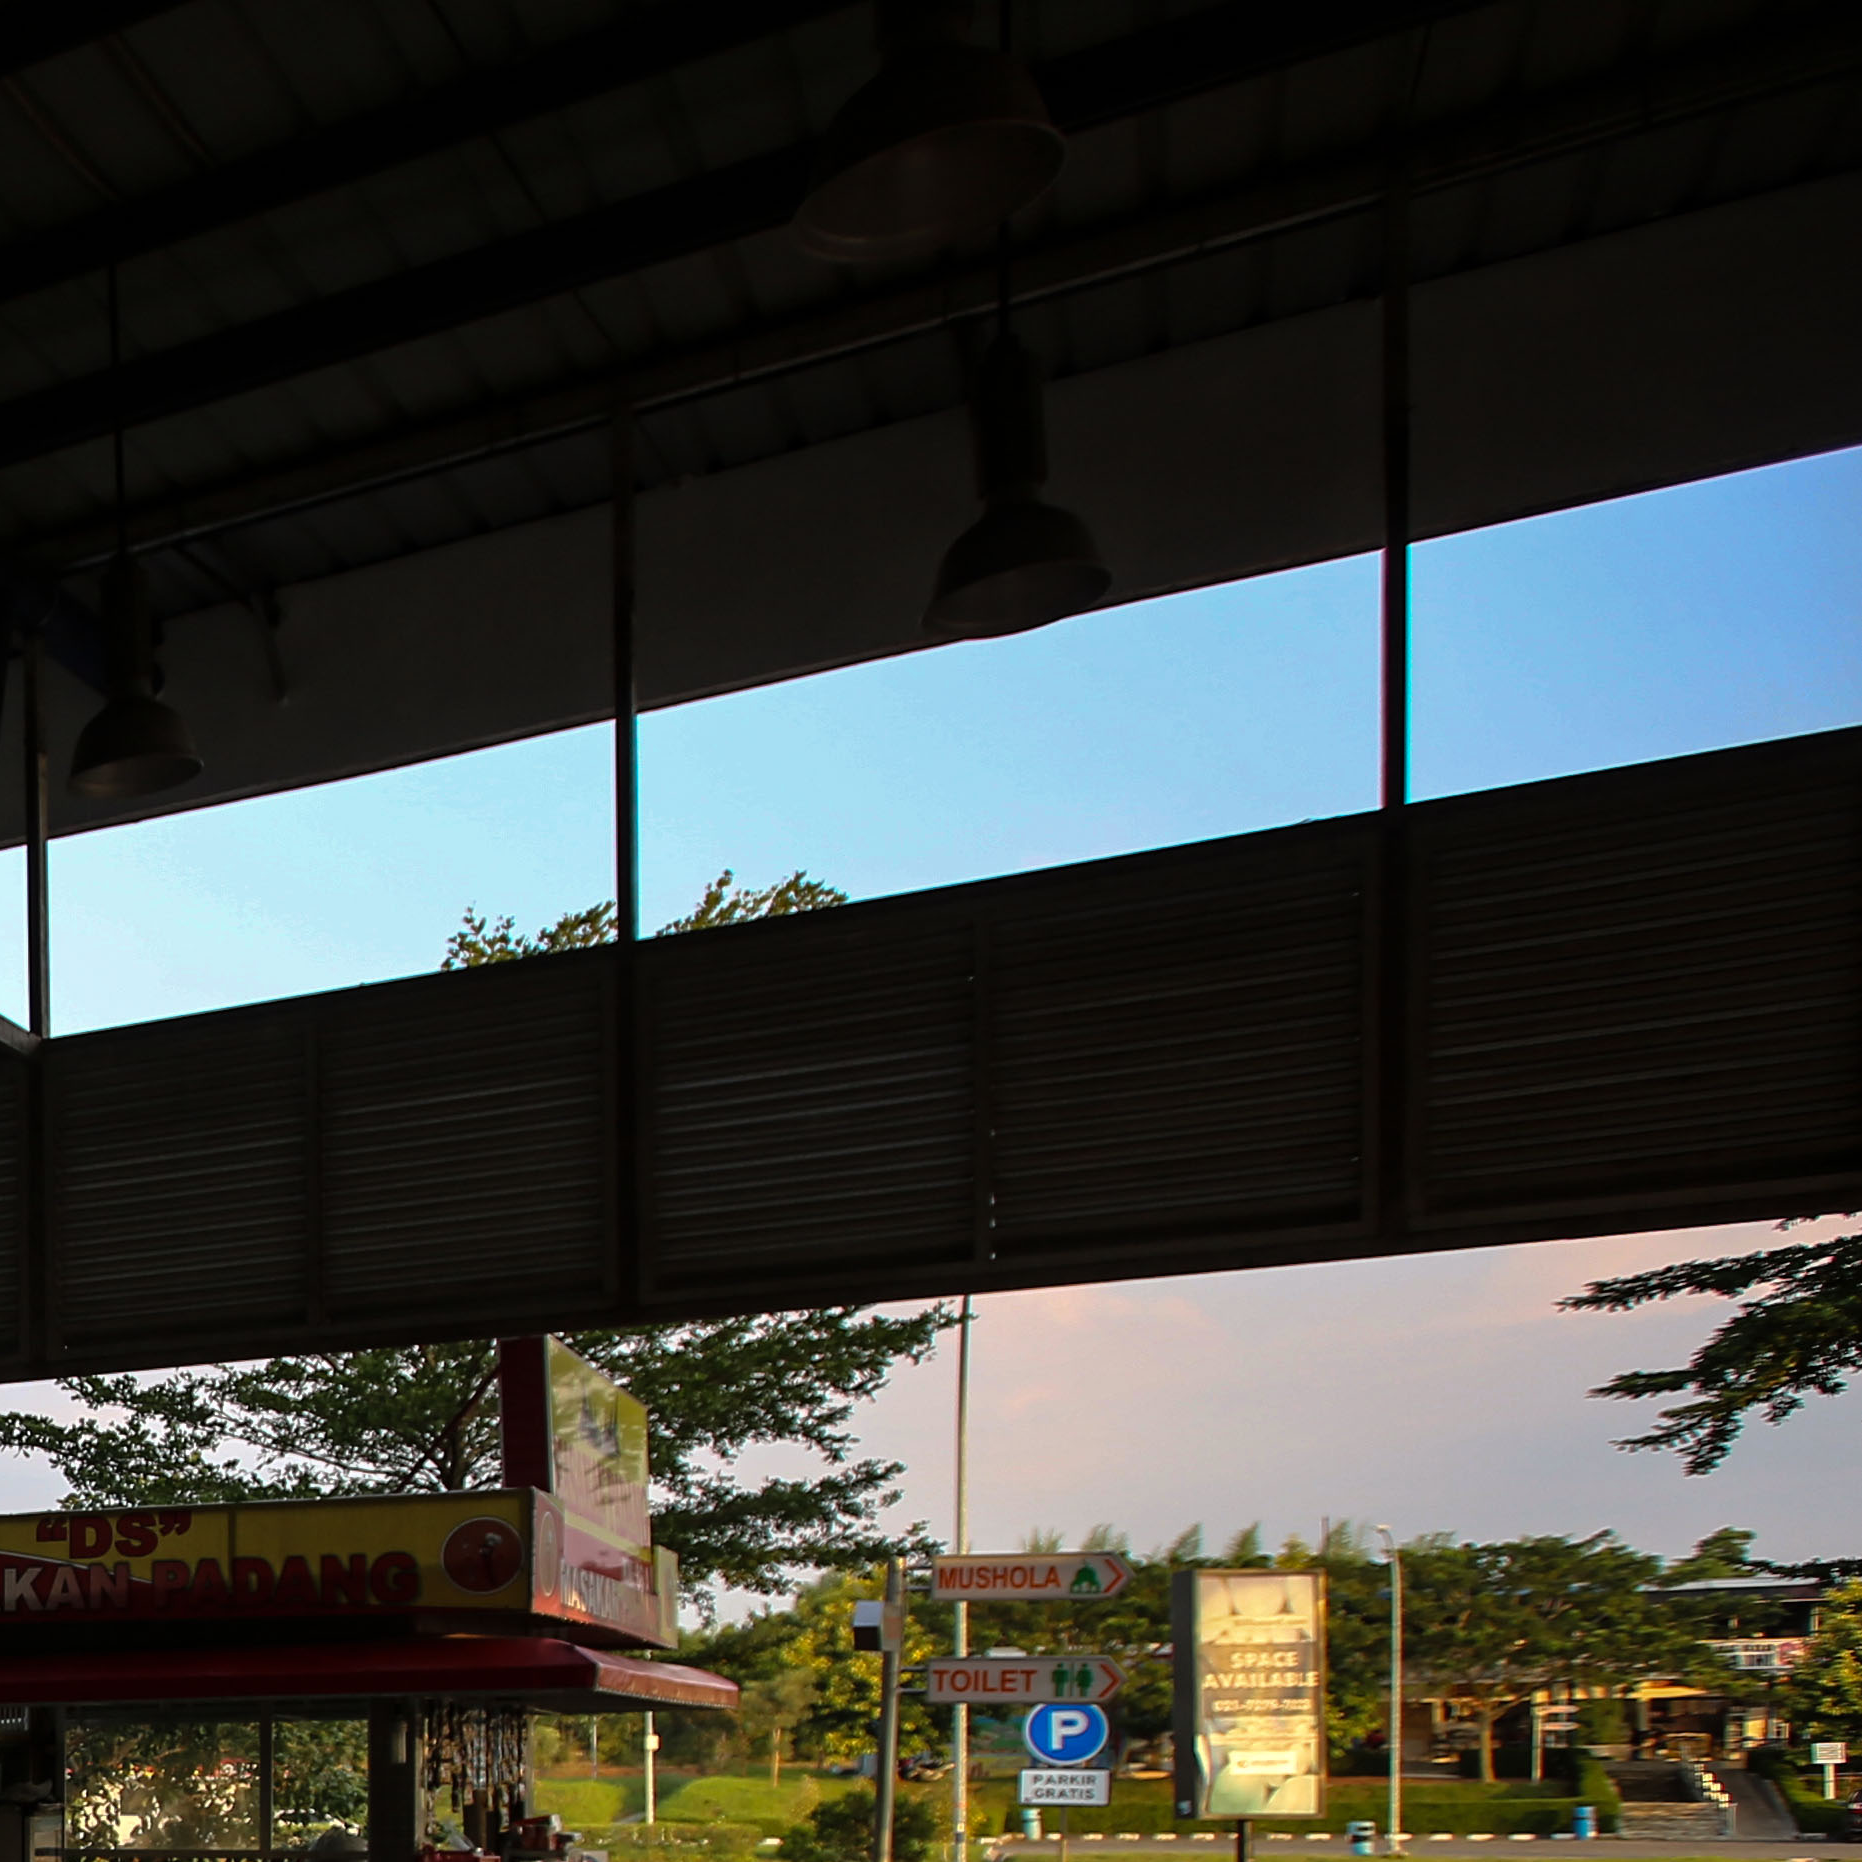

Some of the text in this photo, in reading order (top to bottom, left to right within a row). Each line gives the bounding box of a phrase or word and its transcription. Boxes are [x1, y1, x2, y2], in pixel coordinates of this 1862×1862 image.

[153, 1551, 421, 1609] PADANG
[938, 1566, 1061, 1589] MUSHOLA
[1230, 1651, 1298, 1669] SPACE
[933, 1669, 1038, 1693] TOILET
[1203, 1671, 1320, 1690] AVAILABLE
[1050, 1709, 1090, 1751] P
[1033, 1774, 1096, 1785] PARKIR
[1034, 1788, 1096, 1799] GRATIS
